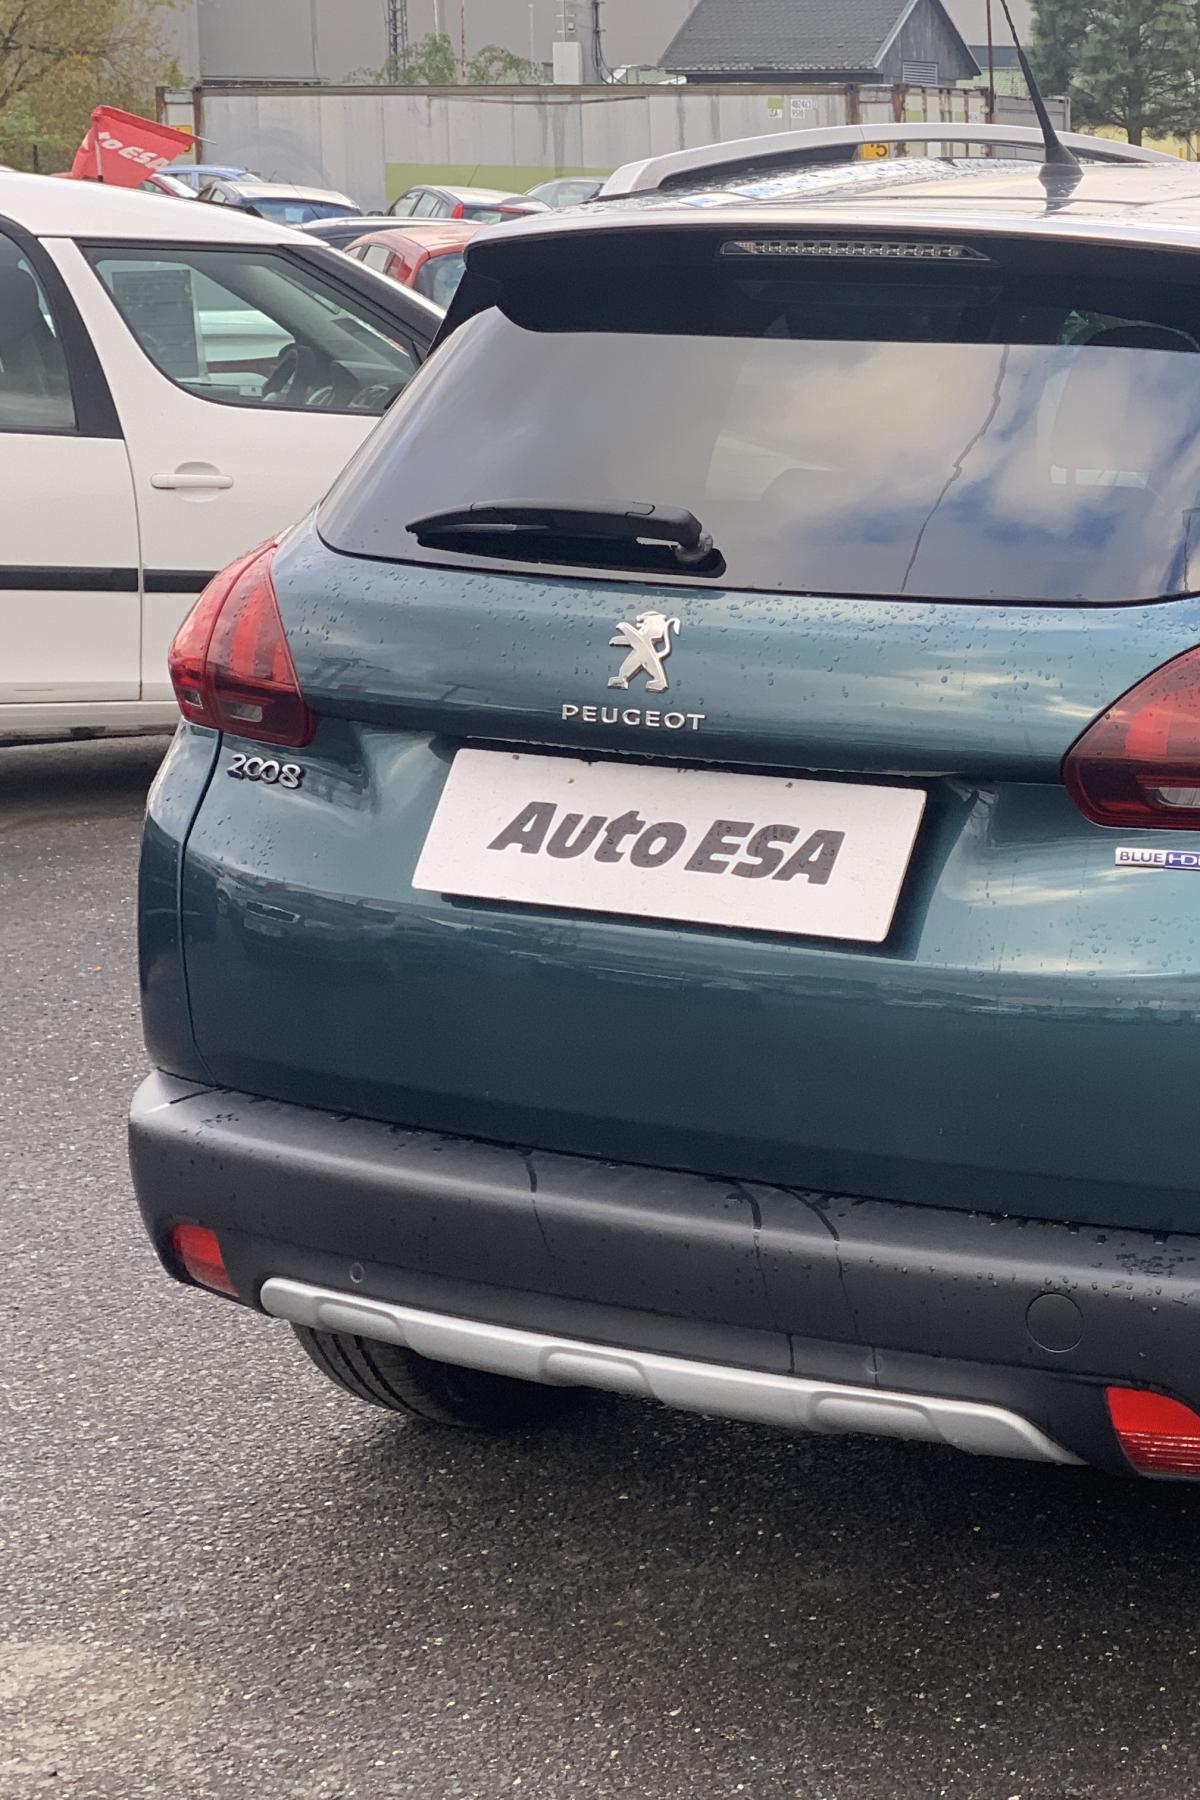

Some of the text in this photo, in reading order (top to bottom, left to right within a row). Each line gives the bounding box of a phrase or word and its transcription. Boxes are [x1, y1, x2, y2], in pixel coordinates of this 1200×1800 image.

[561, 704, 706, 731] PEUGEOT
[227, 753, 302, 789] 2008
[486, 801, 846, 885] Auto ESA
